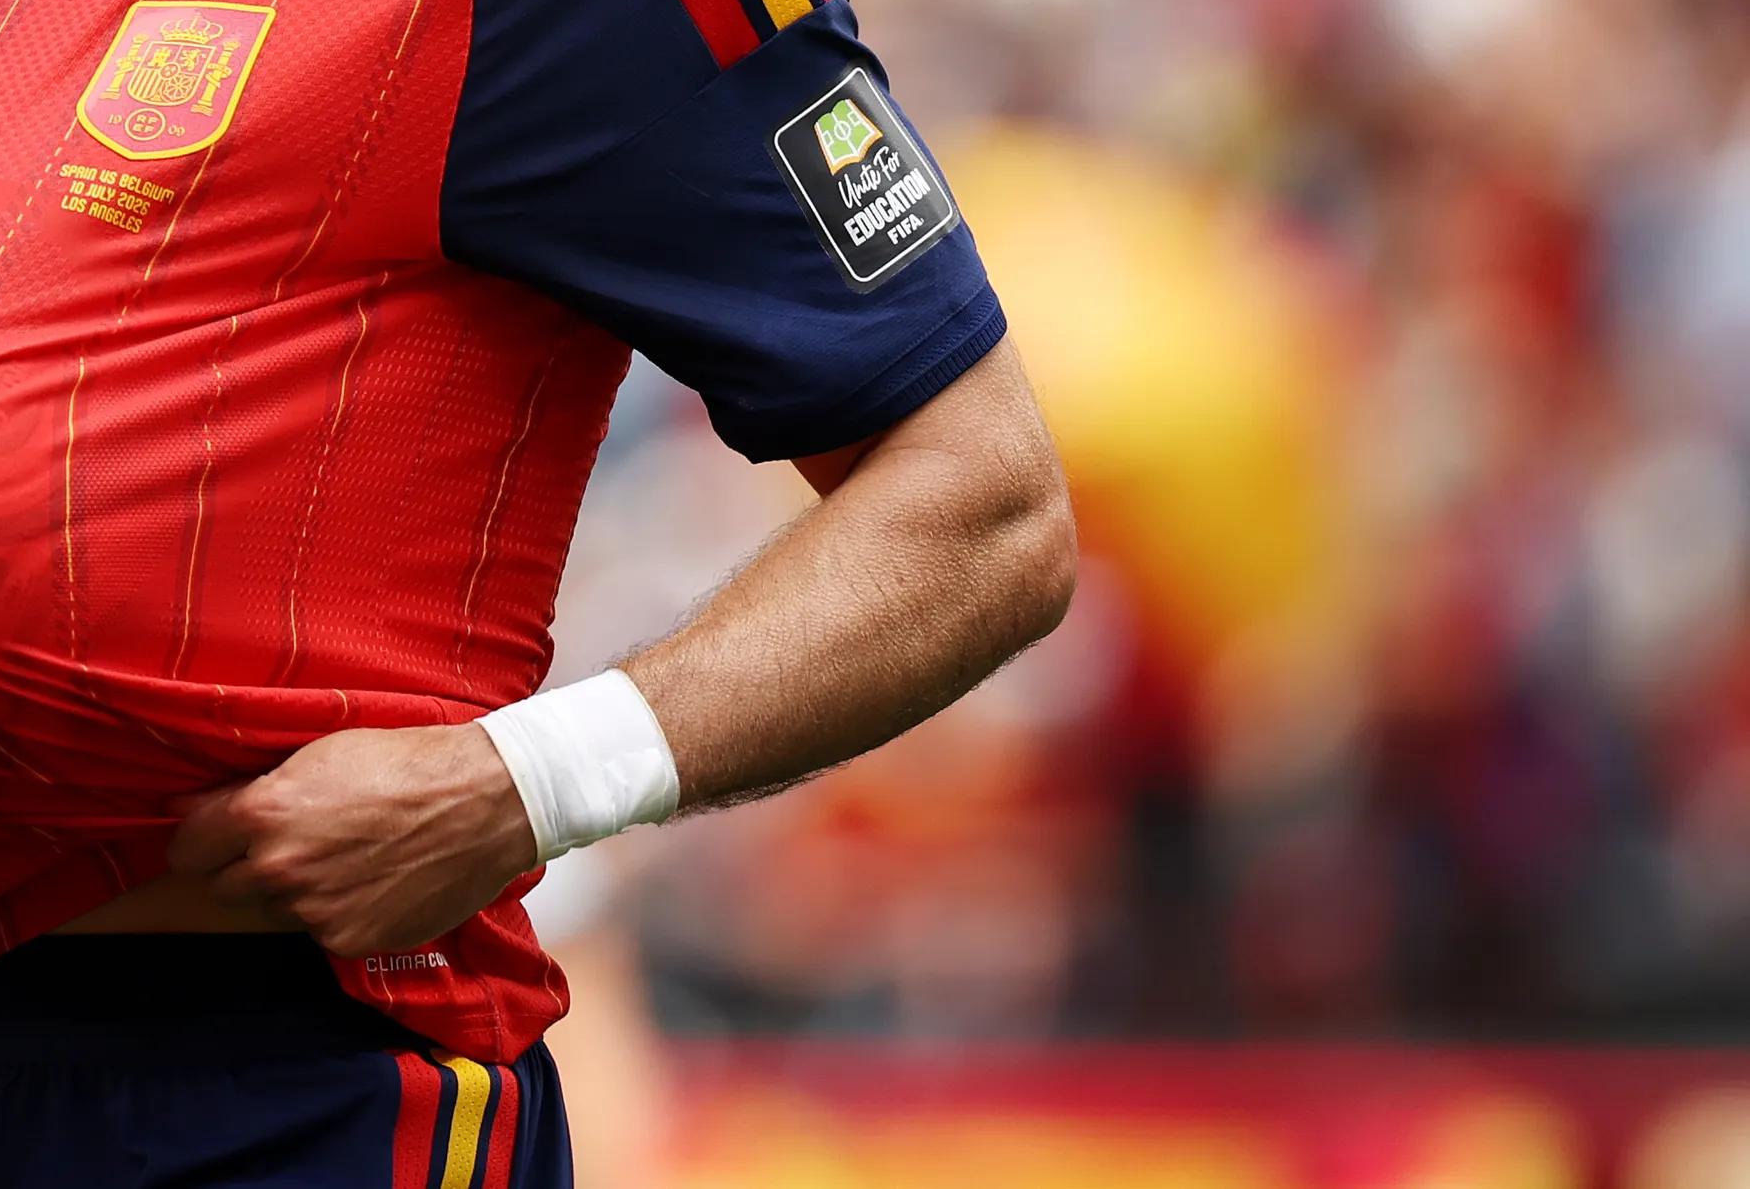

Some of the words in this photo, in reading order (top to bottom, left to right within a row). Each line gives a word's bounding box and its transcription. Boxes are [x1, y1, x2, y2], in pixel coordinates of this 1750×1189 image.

[59, 164, 98, 181] SPAIN
[119, 173, 175, 205] BELGIUM
[838, 164, 881, 209] Unite
[873, 146, 901, 181] For
[61, 195, 87, 213] LOS
[88, 202, 143, 234] ANGELES
[69, 180, 85, 195] 10
[85, 183, 116, 202] JULY
[117, 191, 150, 216] 2026
[844, 168, 931, 247] EDUCATION
[887, 213, 924, 245] FIFA
